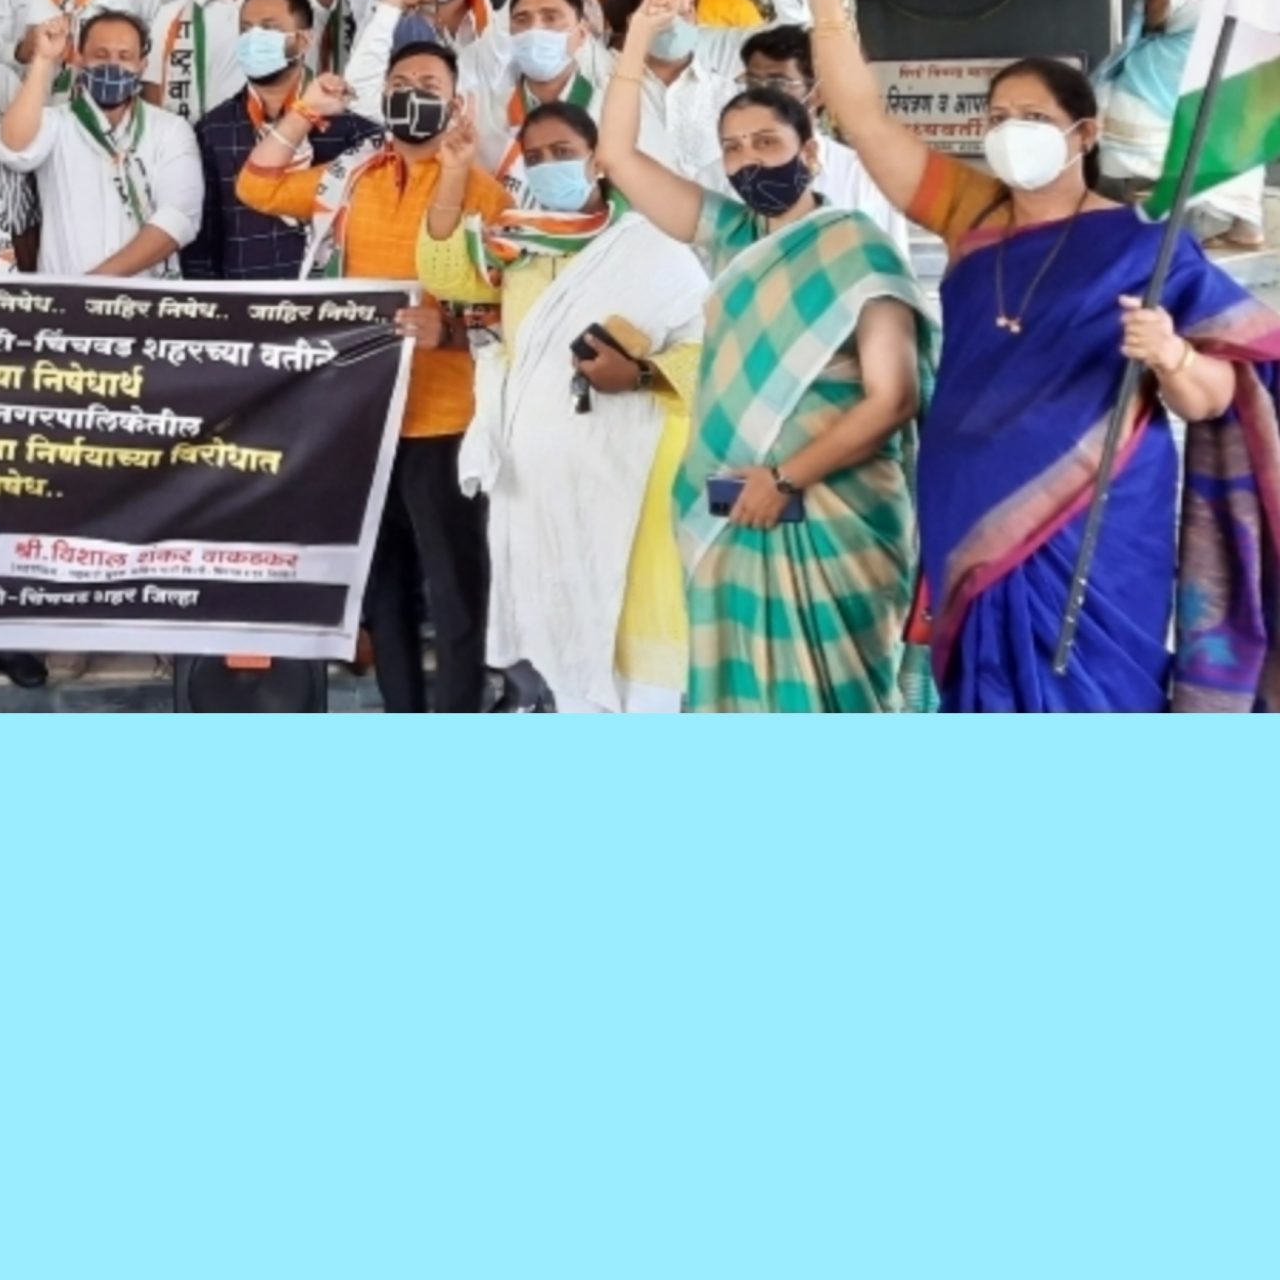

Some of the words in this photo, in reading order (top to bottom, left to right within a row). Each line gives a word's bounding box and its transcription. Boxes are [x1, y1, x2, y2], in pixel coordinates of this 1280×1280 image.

[85, 294, 152, 319] जाहिर
[248, 299, 313, 324] जाहिर
[142, 339, 254, 366] शहरच्या
[259, 337, 338, 372] वतीने
[33, 363, 143, 398] निषेधार्थ
[26, 434, 163, 469] निर्णयाच्या
[171, 436, 284, 475] विरोधात
